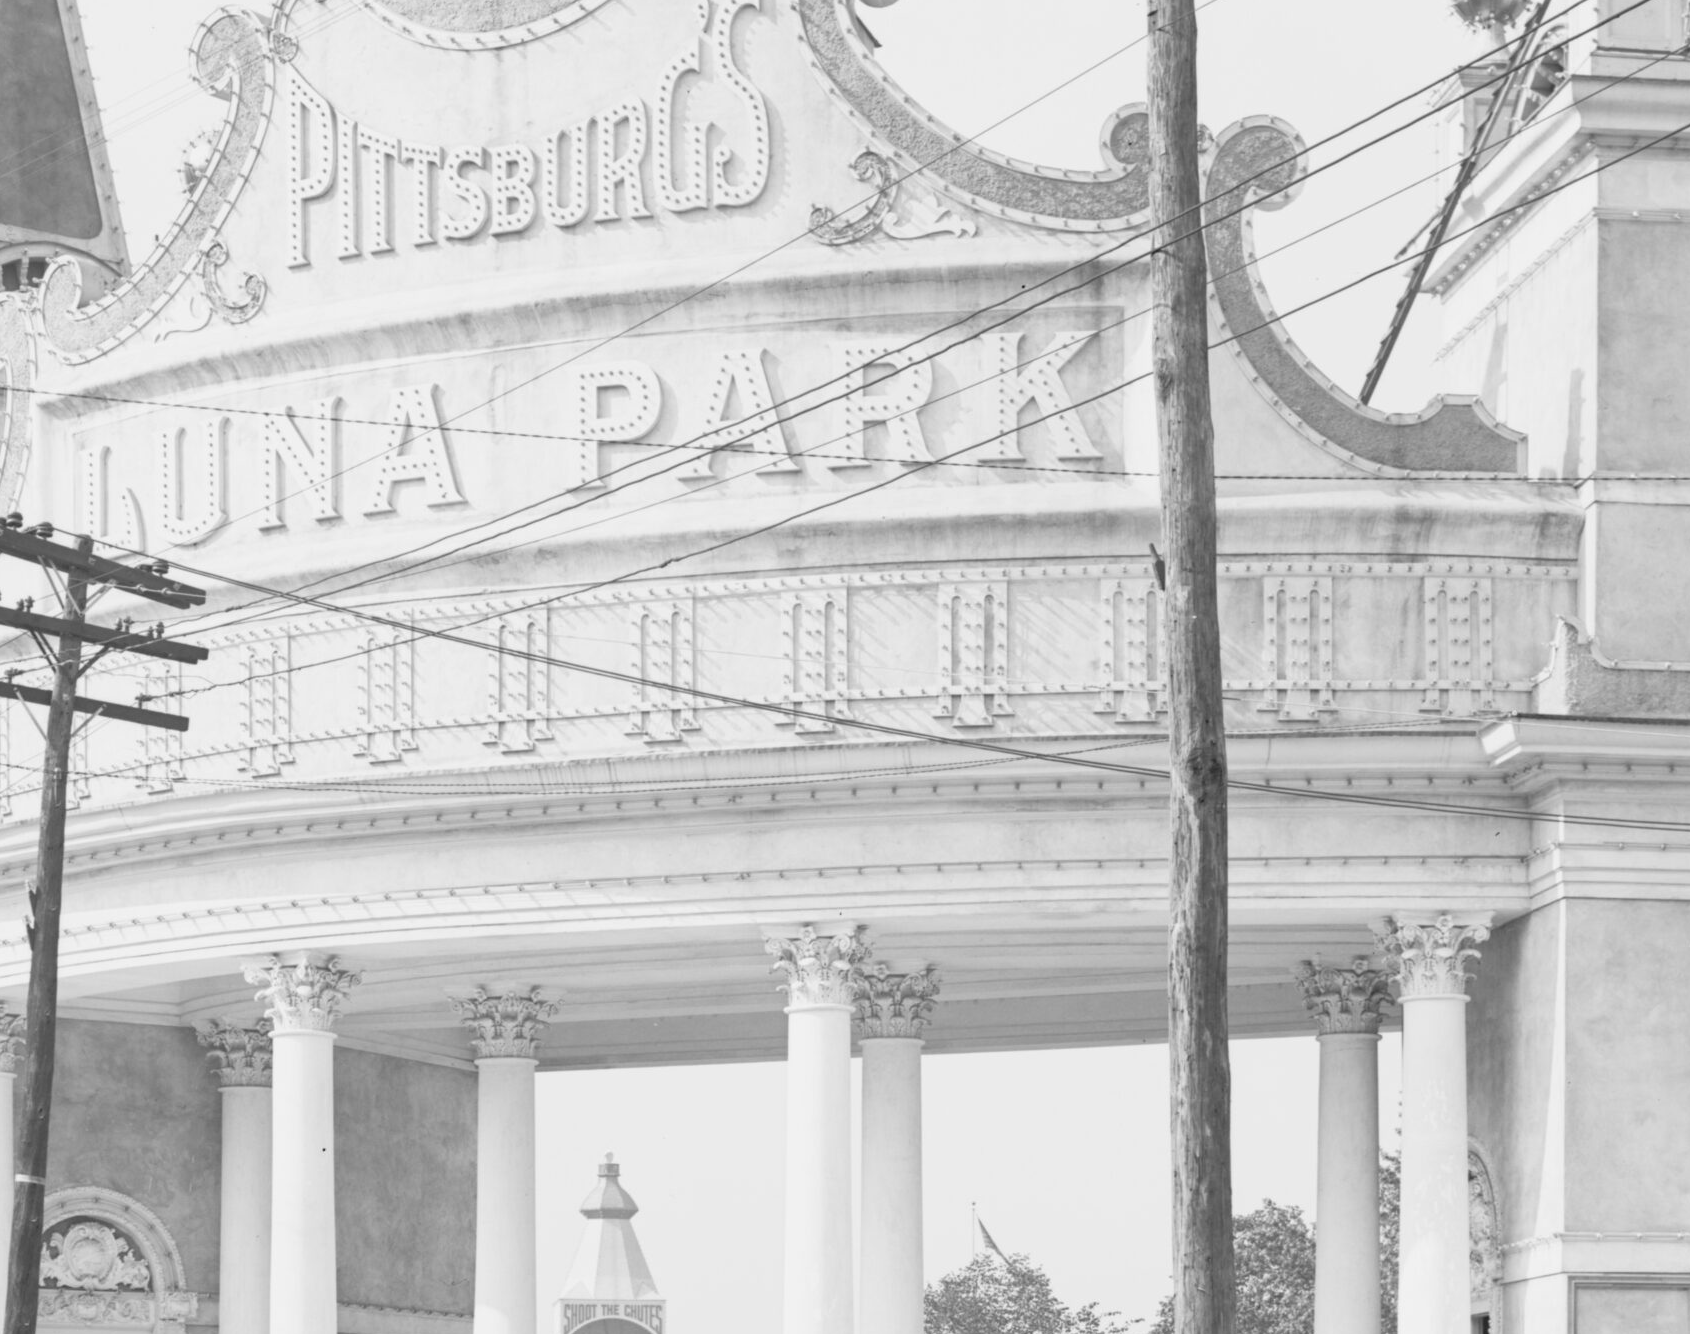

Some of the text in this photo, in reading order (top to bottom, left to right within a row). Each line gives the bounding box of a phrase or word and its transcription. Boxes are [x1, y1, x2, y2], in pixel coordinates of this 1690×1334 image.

[77, 331, 1105, 559] LUNA PARK
[601, 1303, 620, 1317] THE
